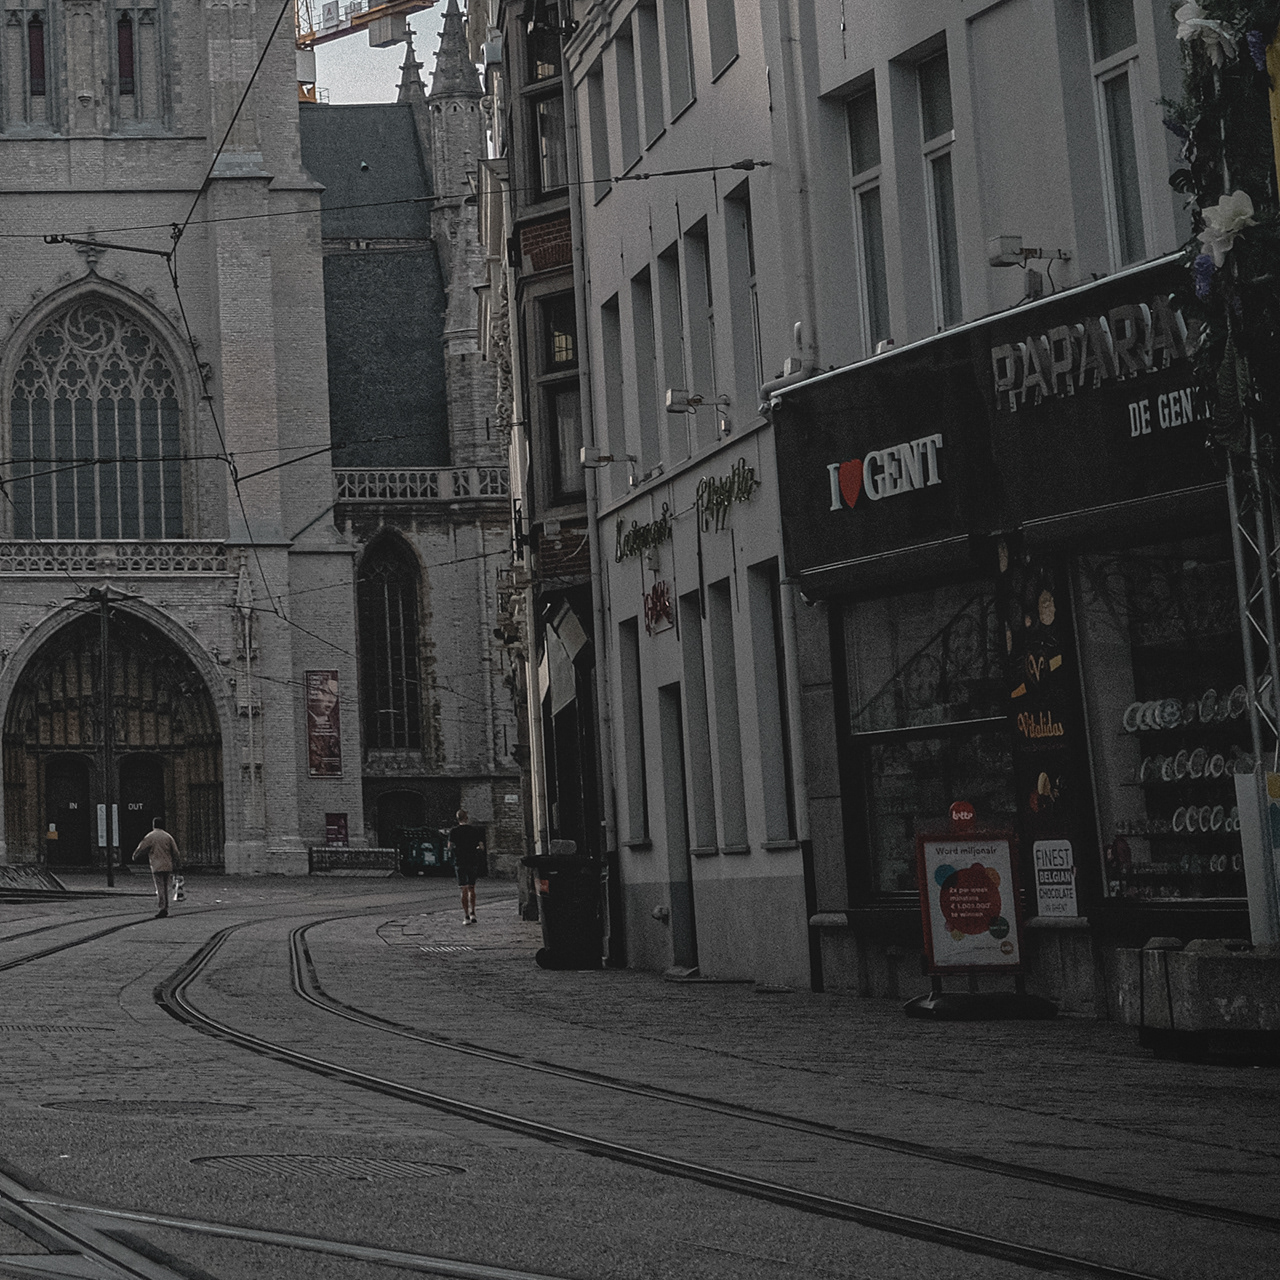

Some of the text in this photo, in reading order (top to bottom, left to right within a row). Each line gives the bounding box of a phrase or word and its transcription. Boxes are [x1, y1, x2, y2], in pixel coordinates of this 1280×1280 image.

[1128, 400, 1152, 438] DE
[826, 463, 843, 512] I
[862, 433, 944, 501] GENT
[69, 801, 78, 810] IN
[127, 802, 144, 811] OUT
[936, 847, 958, 856] Word
[1036, 848, 1070, 867] FINEST
[1039, 870, 1073, 883] BELGIAN
[1039, 888, 1074, 899] CHOCOLATE
